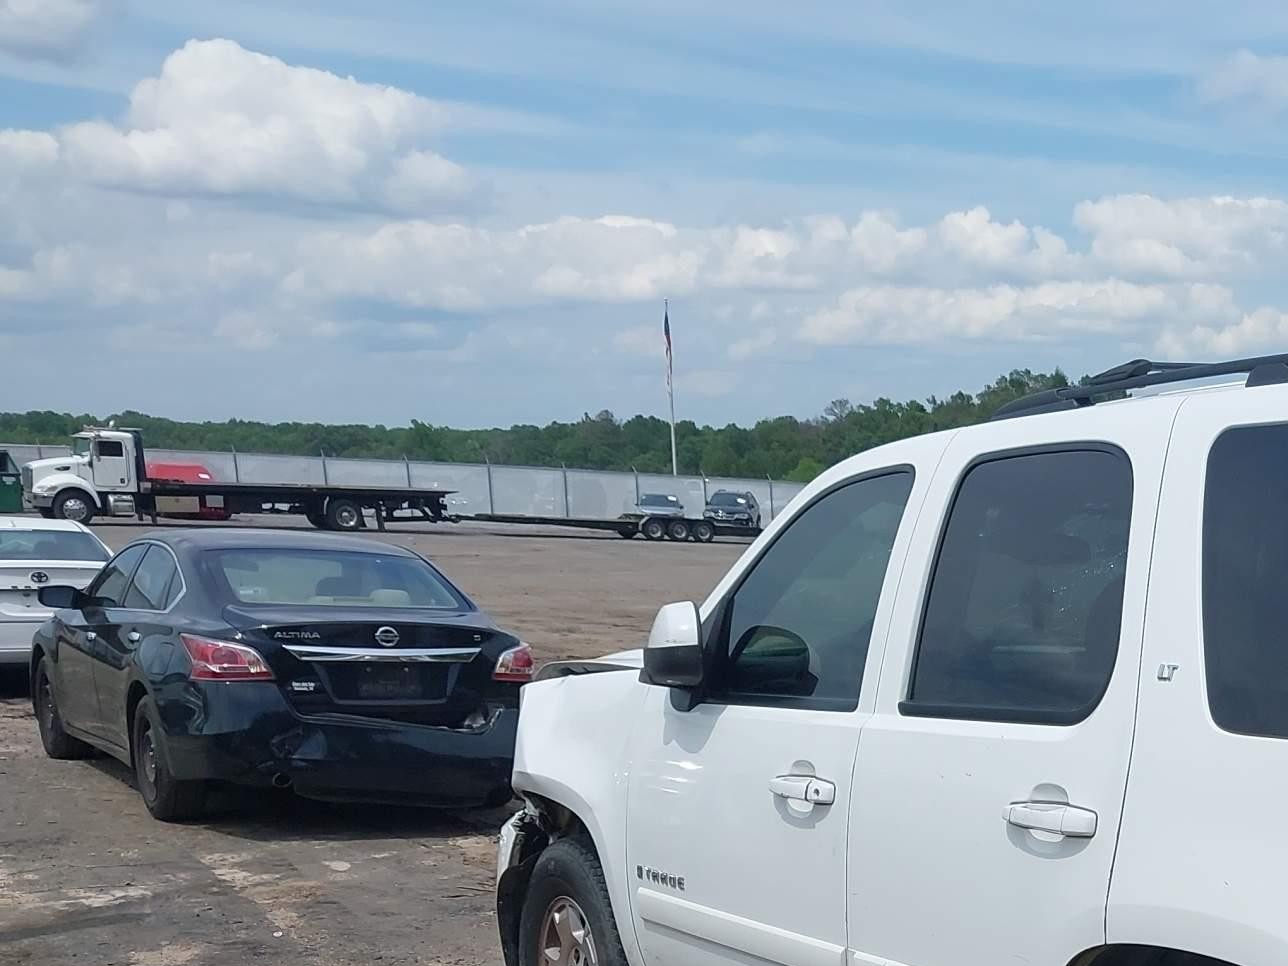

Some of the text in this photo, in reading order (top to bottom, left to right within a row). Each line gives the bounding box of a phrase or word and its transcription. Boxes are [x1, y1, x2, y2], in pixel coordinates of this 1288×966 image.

[273, 631, 321, 639] ALTIMA
[1157, 664, 1179, 682] LT
[644, 866, 686, 892] TAHOE
